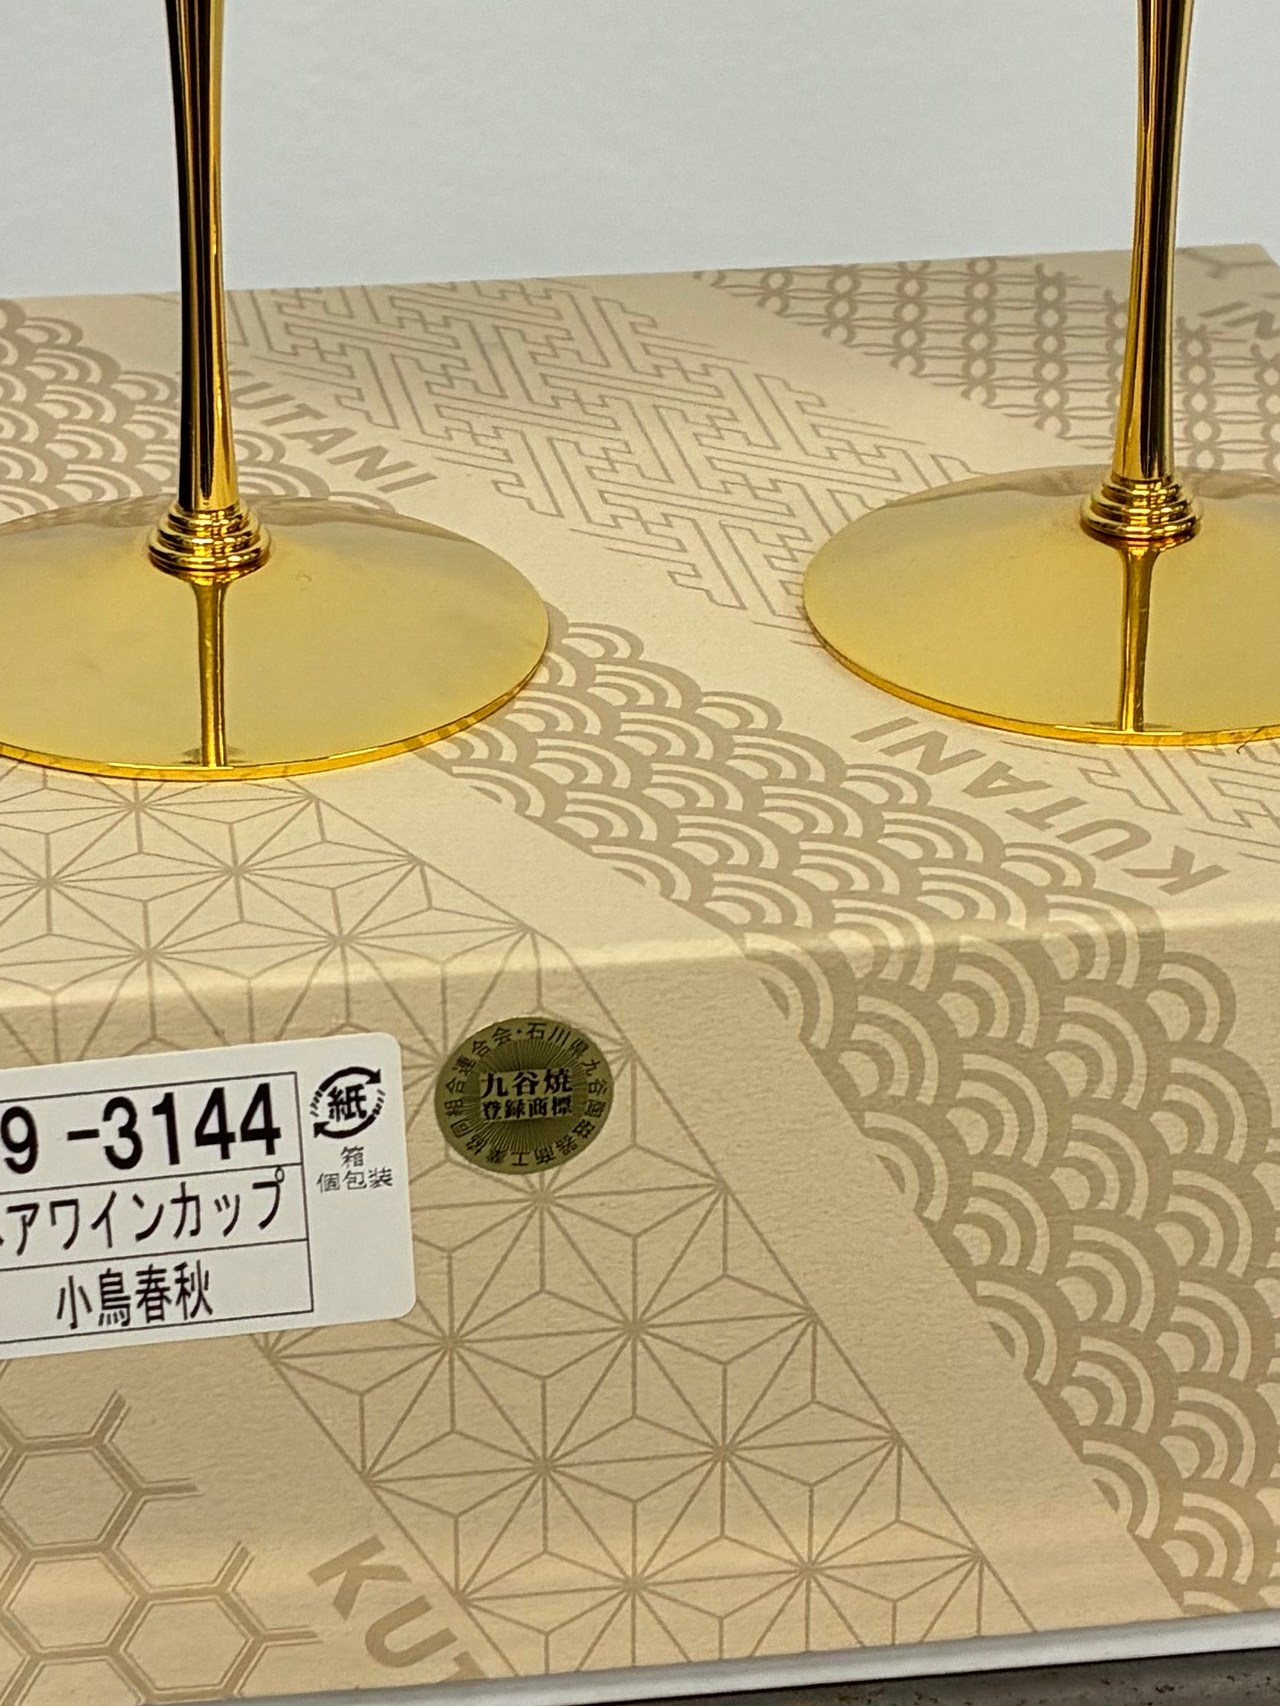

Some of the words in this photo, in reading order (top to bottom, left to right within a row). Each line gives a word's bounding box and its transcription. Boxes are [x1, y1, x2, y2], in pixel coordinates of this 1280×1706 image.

[229, 369, 438, 493] UTANI
[851, 716, 1230, 895] KUTANI
[327, 1083, 368, 1122] 紙
[479, 1068, 573, 1099] 九谷焼
[482, 1096, 573, 1121] 登録商標
[316, 1167, 393, 1193] 個包装
[57, 1260, 214, 1330] 小鳥春秋
